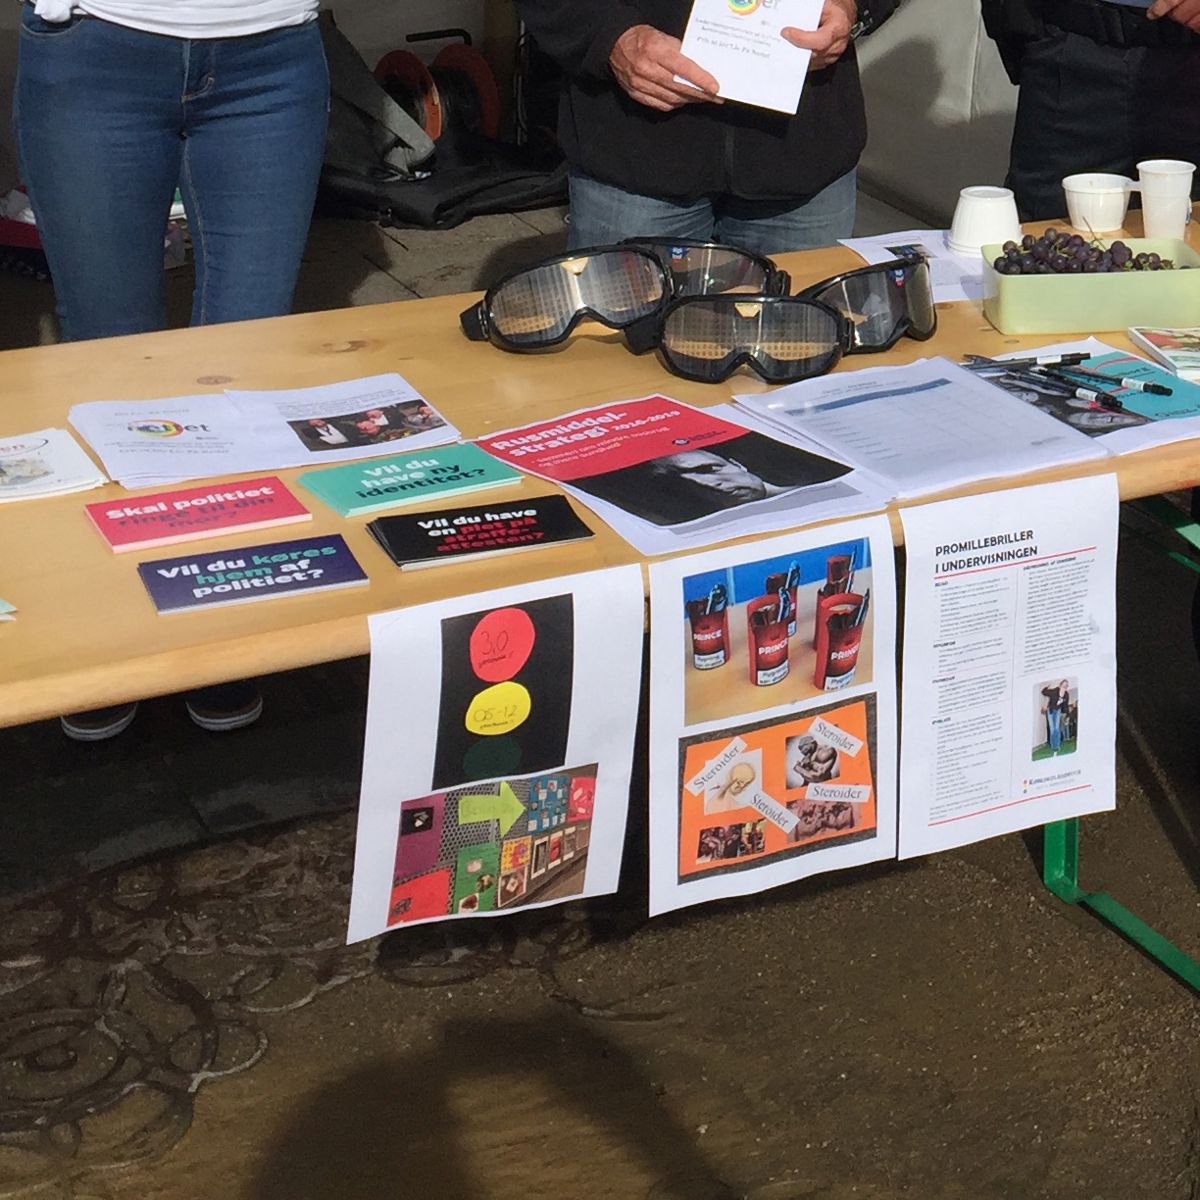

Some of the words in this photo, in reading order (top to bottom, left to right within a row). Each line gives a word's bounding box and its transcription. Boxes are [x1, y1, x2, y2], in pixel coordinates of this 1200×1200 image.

[491, 411, 628, 450] Rusmiddel-
[510, 427, 610, 457] strategi
[360, 471, 426, 488] have
[430, 464, 460, 475] ny
[363, 464, 402, 478] Vil
[405, 459, 440, 469] du
[355, 468, 486, 499] identitet?
[106, 502, 168, 519] Skal
[173, 486, 275, 511] politiet
[418, 518, 449, 530] Vil
[453, 516, 482, 526] du
[484, 509, 537, 521] have
[428, 528, 457, 537] en
[934, 529, 1035, 557] PROMILLEBRILLER
[157, 563, 200, 578] Vil
[207, 559, 246, 572] du
[251, 546, 337, 566] køres
[195, 567, 273, 585] hjem
[280, 558, 311, 573] af
[941, 546, 1038, 572] UNDERVISNINGEN
[192, 569, 324, 598] politiet?
[694, 629, 722, 641] PRINCE
[817, 720, 855, 752] Steroider
[693, 744, 741, 789] Steroider
[812, 786, 863, 800] Steroider
[751, 793, 789, 828] Steroider
